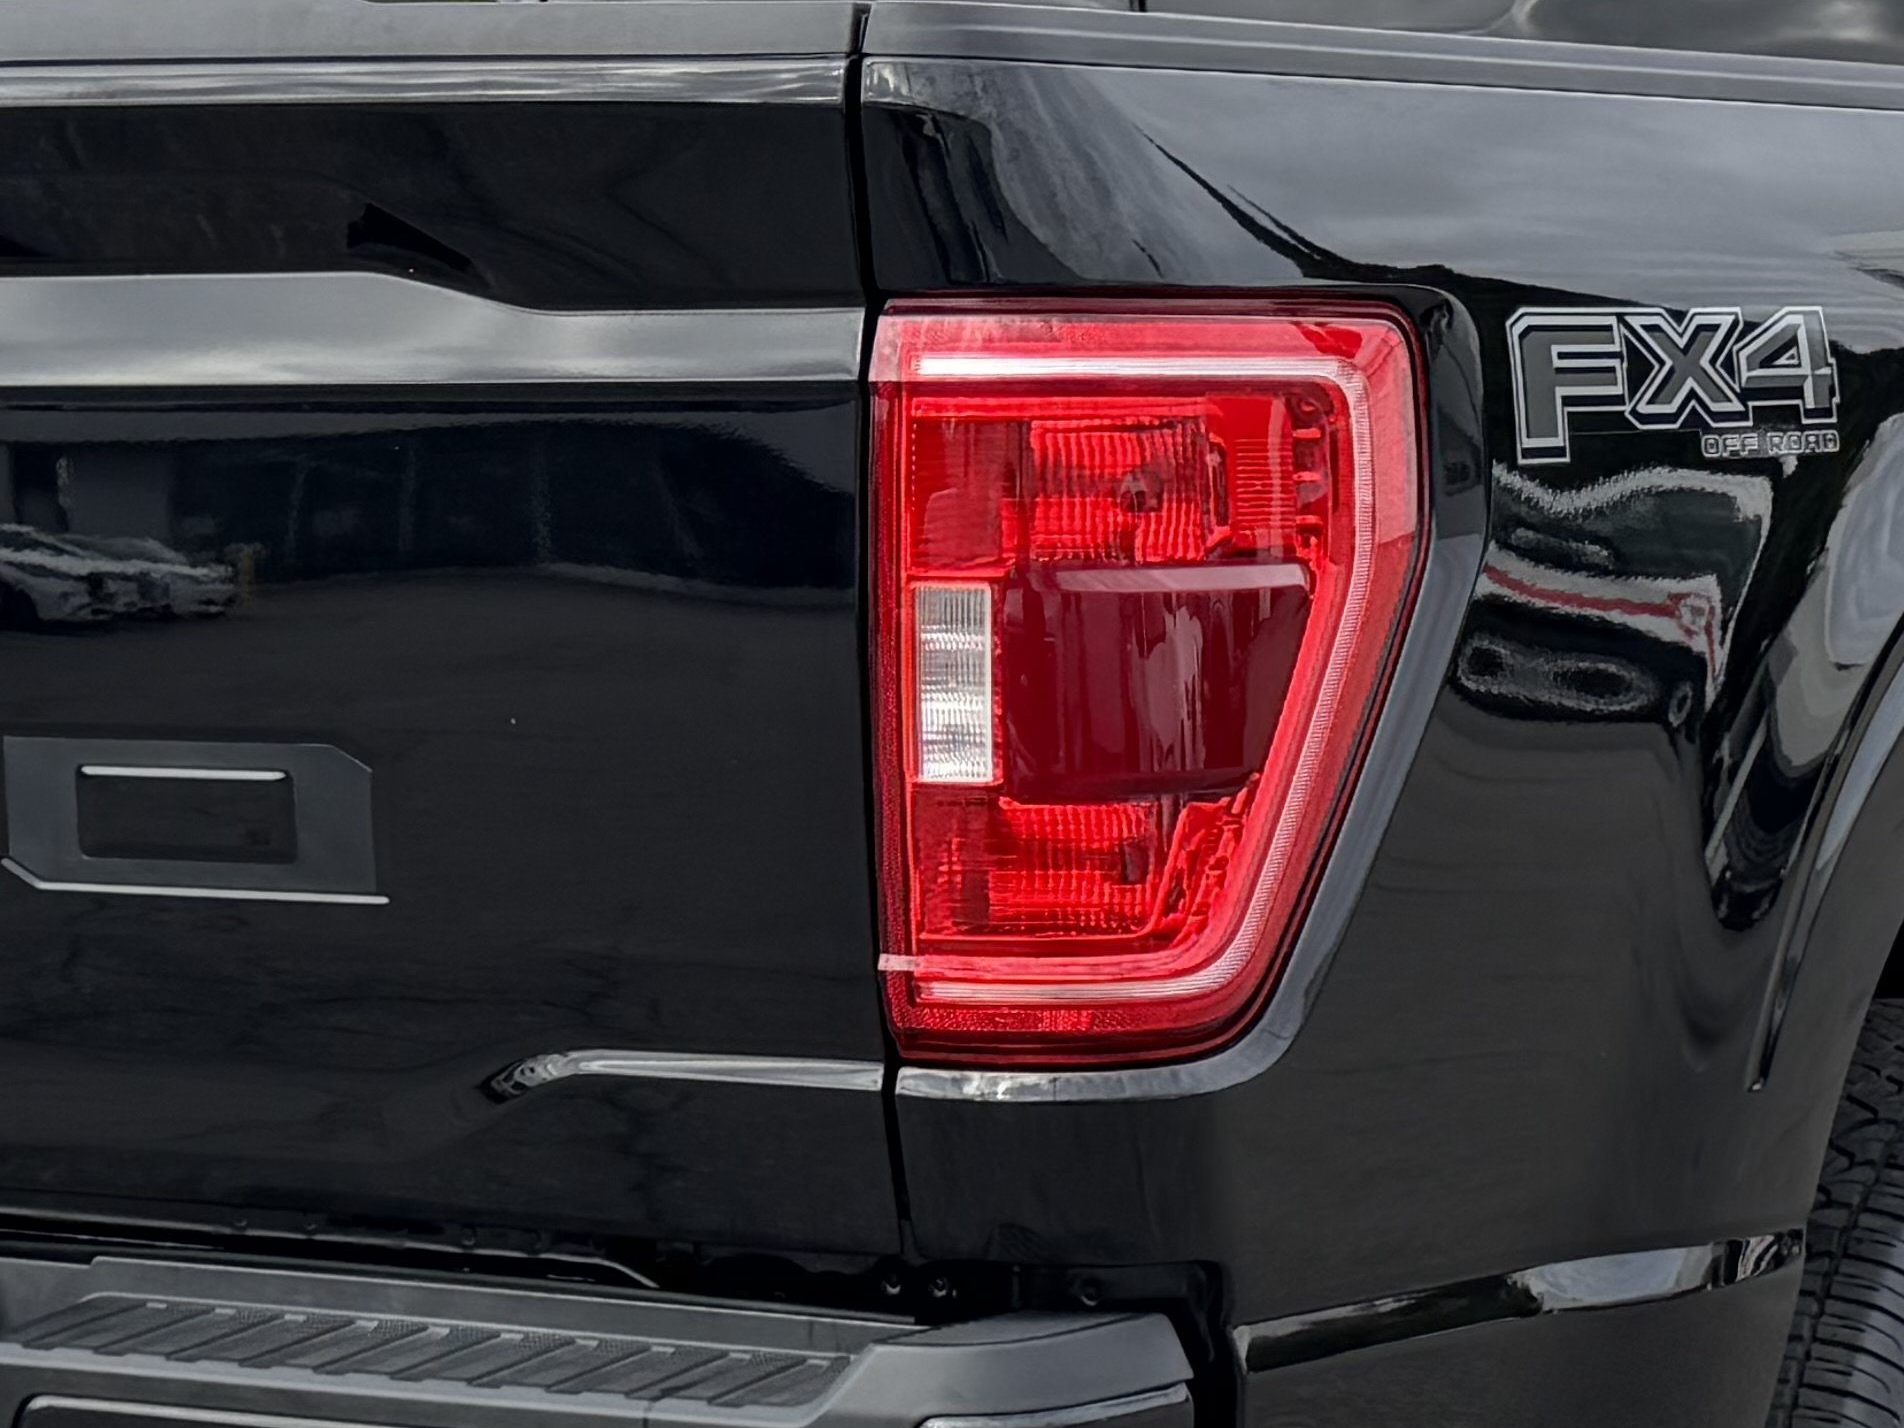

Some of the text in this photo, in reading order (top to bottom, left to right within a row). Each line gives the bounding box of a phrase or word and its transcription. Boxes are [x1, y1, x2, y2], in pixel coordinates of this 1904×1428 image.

[1505, 306, 1840, 465] FX4
[1701, 429, 1841, 459] OFF ROAD
